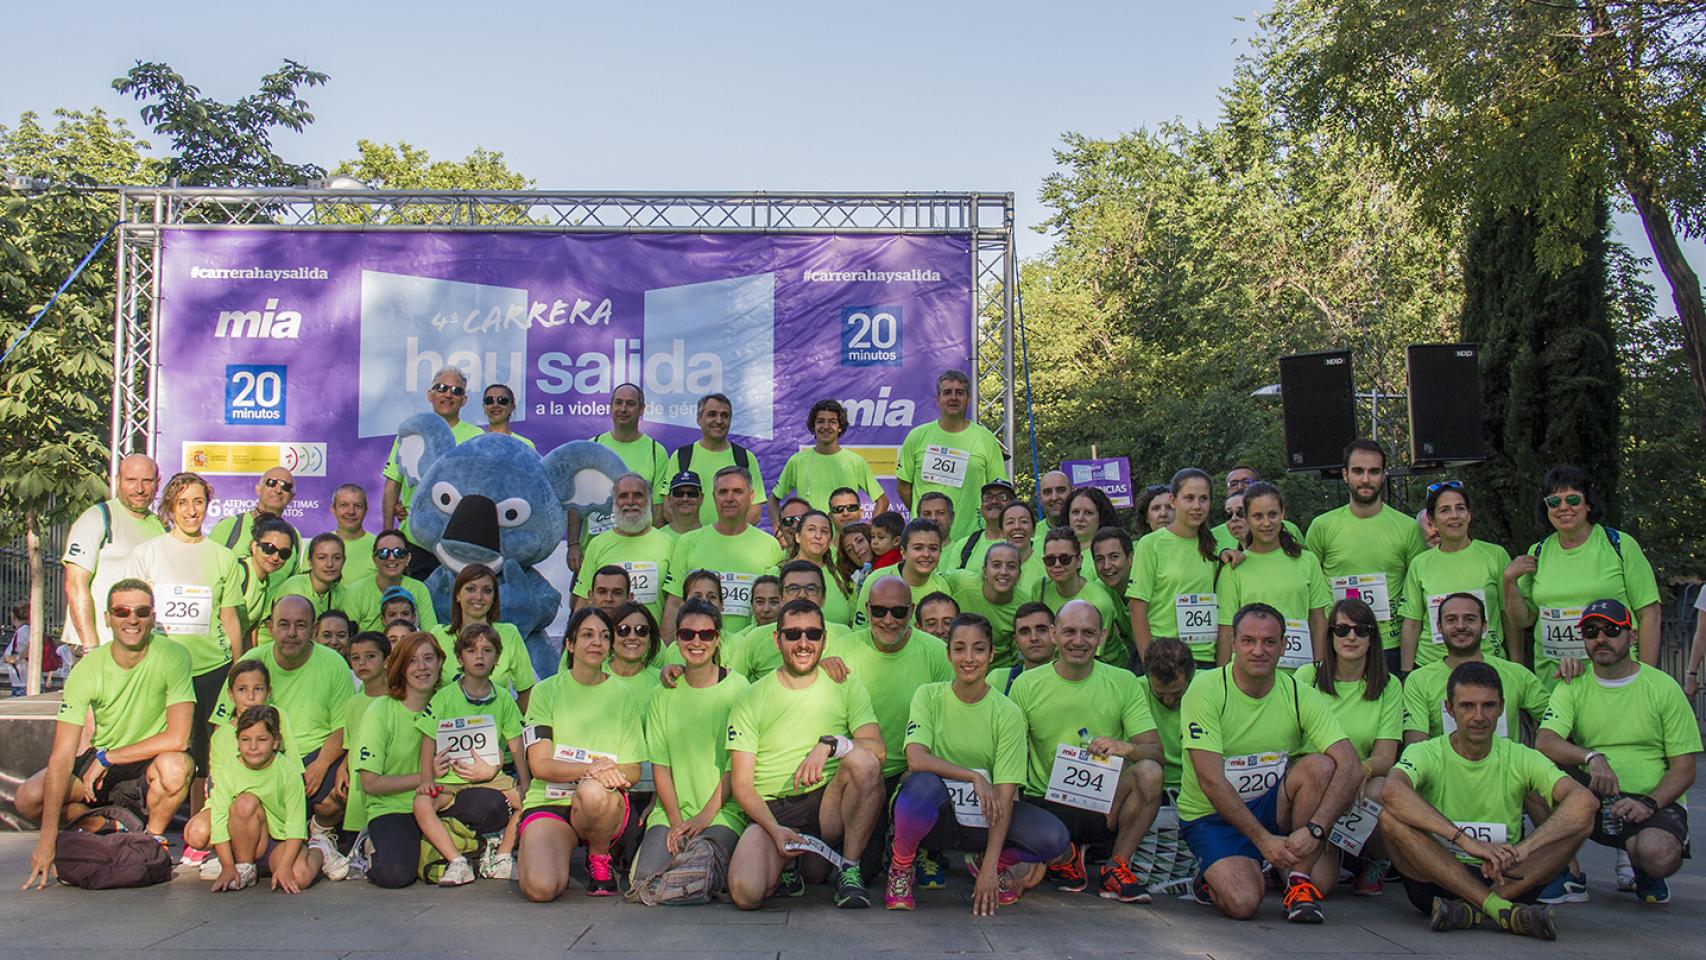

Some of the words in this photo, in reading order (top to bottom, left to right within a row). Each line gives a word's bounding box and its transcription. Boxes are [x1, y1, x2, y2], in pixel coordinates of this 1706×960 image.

[190, 266, 329, 282] #carrerahaysalida
[802, 269, 942, 284] #carrerahaysalida
[214, 298, 302, 339] mia
[463, 298, 613, 334] CARRERA
[848, 312, 897, 349] 20
[848, 350, 897, 361] minutos
[536, 338, 723, 395] salida
[232, 371, 281, 407] 20
[232, 408, 281, 419] minutos
[535, 404, 546, 416] a
[550, 401, 564, 416] la
[838, 386, 916, 427] mia
[932, 458, 956, 474] 261
[631, 575, 648, 589] 42
[164, 601, 200, 618] 236
[1185, 610, 1212, 627] 264
[448, 733, 486, 752] 209
[1063, 766, 1105, 792] 294
[1239, 772, 1279, 793] 220
